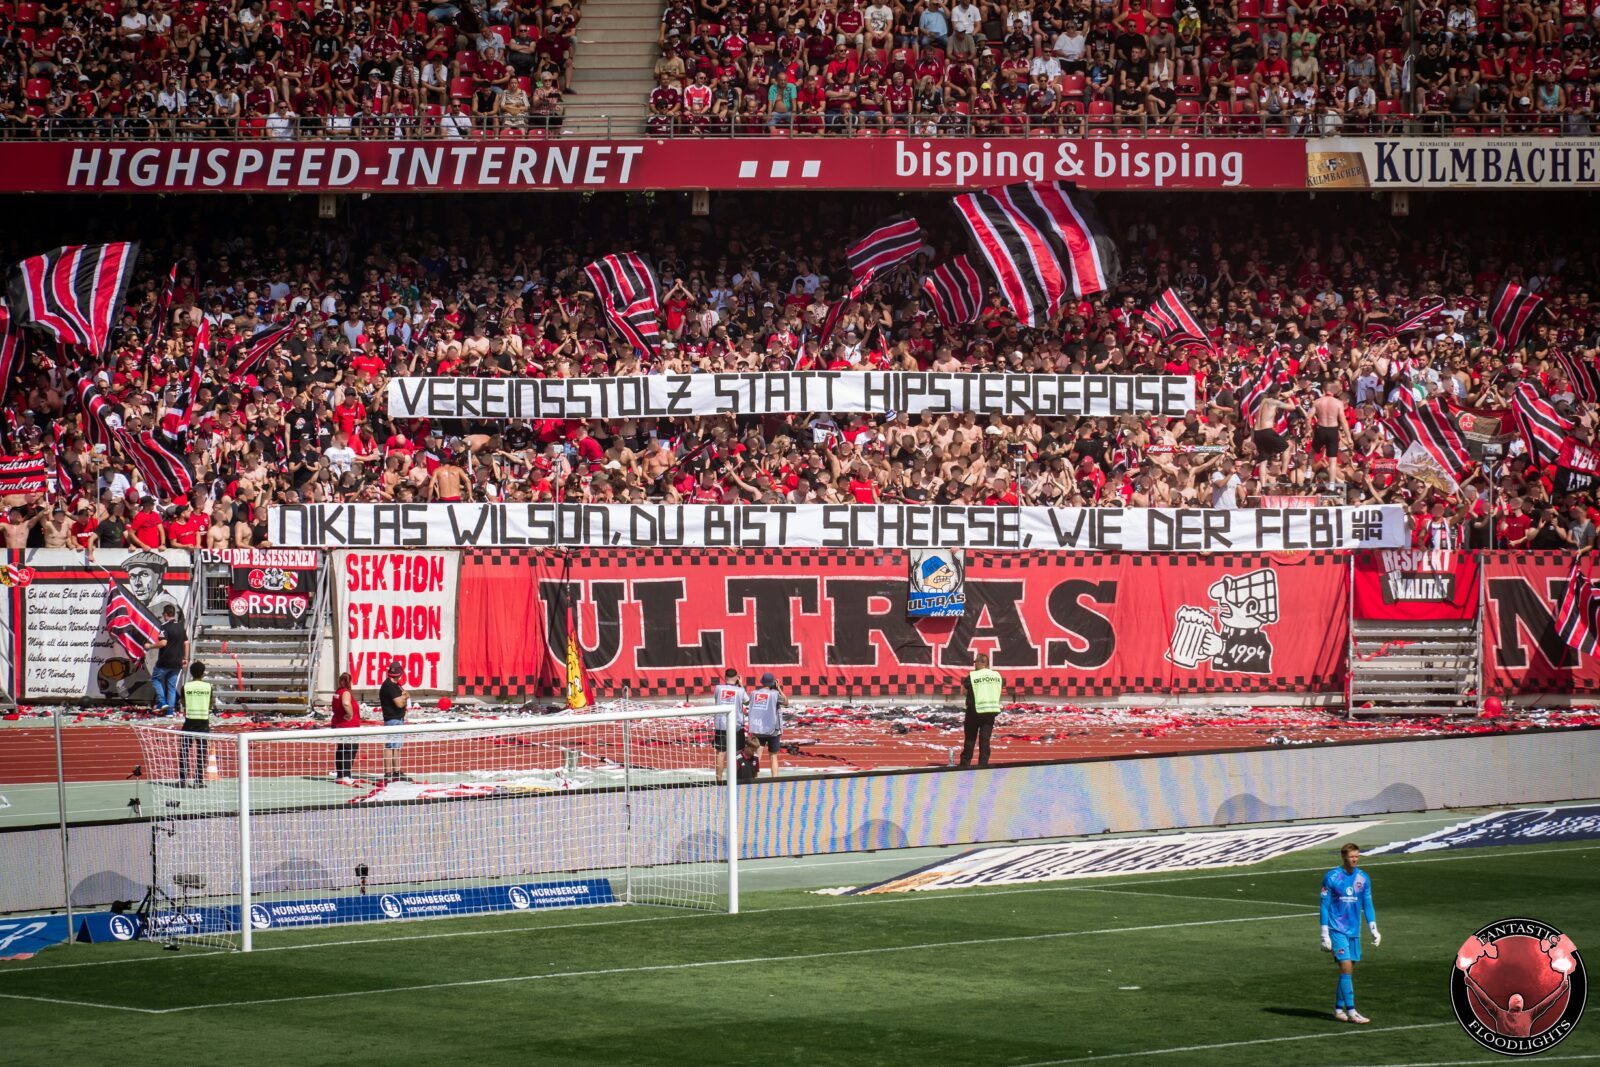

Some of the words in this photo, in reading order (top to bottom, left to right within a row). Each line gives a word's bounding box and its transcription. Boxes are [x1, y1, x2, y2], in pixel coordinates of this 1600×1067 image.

[67, 146, 643, 186] HIGHSPEED-INTERNET
[896, 140, 1044, 185] bisping
[1055, 142, 1085, 176] &
[1095, 142, 1243, 186] bisping
[1306, 167, 1362, 187] KULMBACHER
[1374, 142, 1600, 182] KULMBACHE
[398, 374, 692, 416] VEREINSSTOLZ
[715, 371, 841, 414] STATT
[864, 372, 1188, 415] HIPSTERGEPOSE
[279, 504, 428, 546] NIKLAS
[704, 505, 796, 547] BIST
[822, 505, 1033, 549] SCHEISSE,
[1048, 507, 1124, 549] WIE
[1148, 508, 1233, 551] DER
[1255, 507, 1344, 549] FCB!
[233, 548, 251, 566] DIE
[252, 548, 316, 567] BESESSENEN
[345, 553, 444, 593] SEKTION
[1382, 549, 1450, 573] RESPEKT
[248, 594, 287, 615] RSR
[348, 602, 441, 641] STADION
[907, 592, 966, 612] ULTRAS
[535, 575, 1117, 672] ULTRAS
[1229, 644, 1265, 663] 1994
